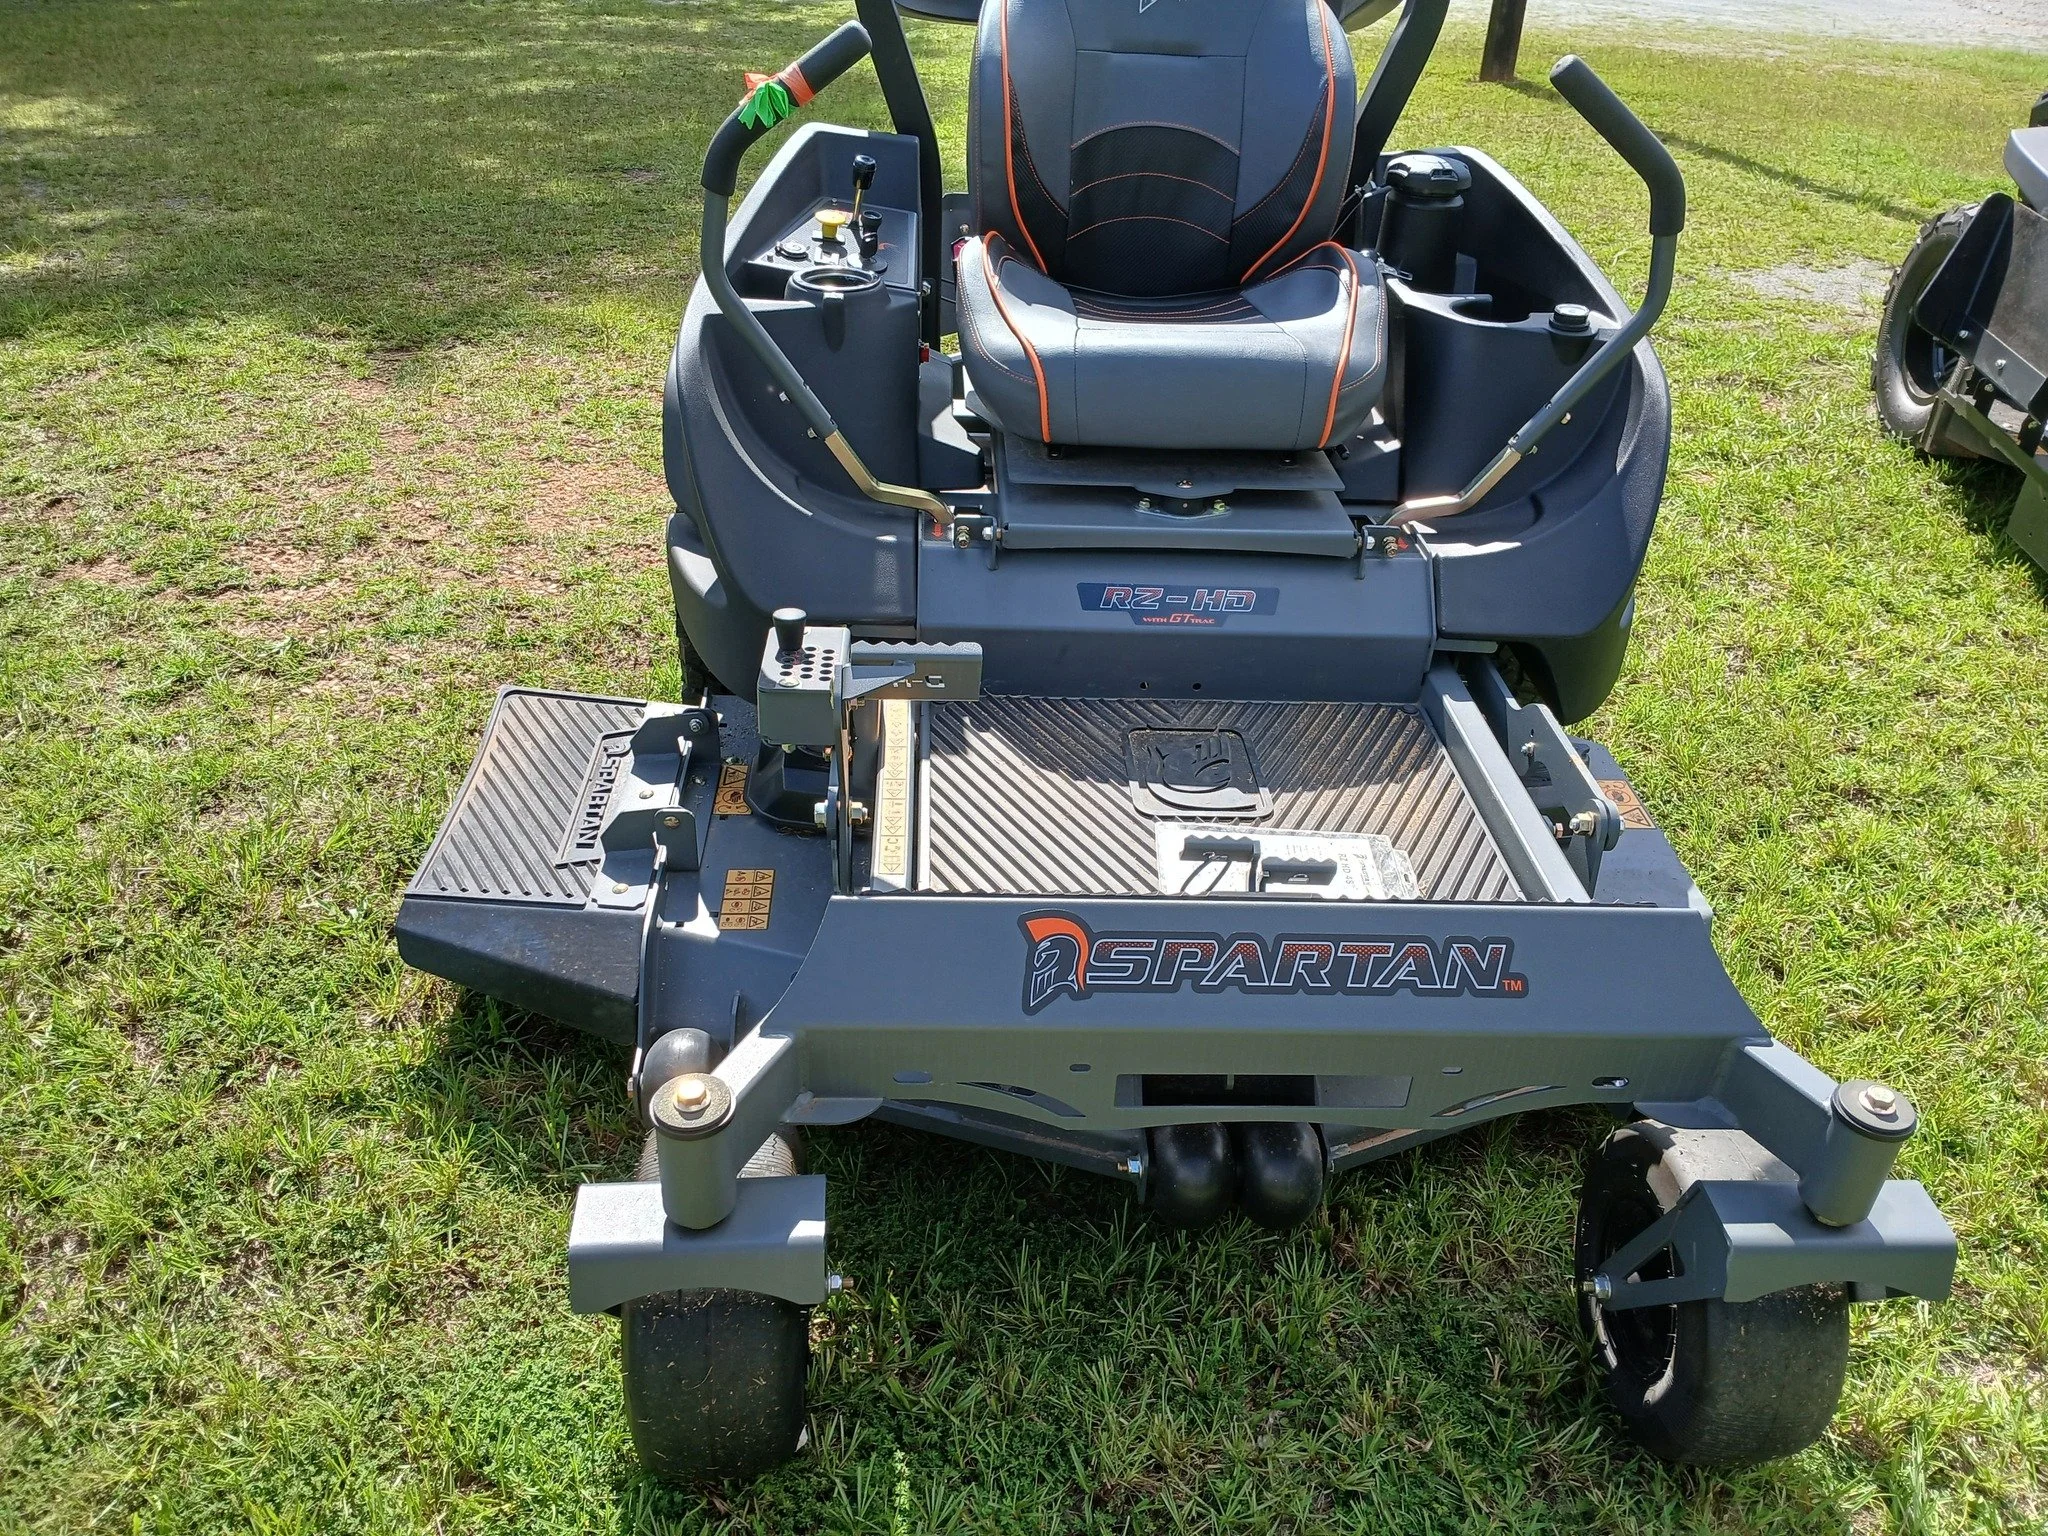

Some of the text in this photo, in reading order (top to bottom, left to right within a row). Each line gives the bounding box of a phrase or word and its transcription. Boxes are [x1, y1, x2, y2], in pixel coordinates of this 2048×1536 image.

[1100, 586, 1257, 612] RZ-HD
[1142, 616, 1168, 624] WITH
[576, 753, 622, 849] SPARTAN
[1086, 938, 1506, 990] SPARTAN
